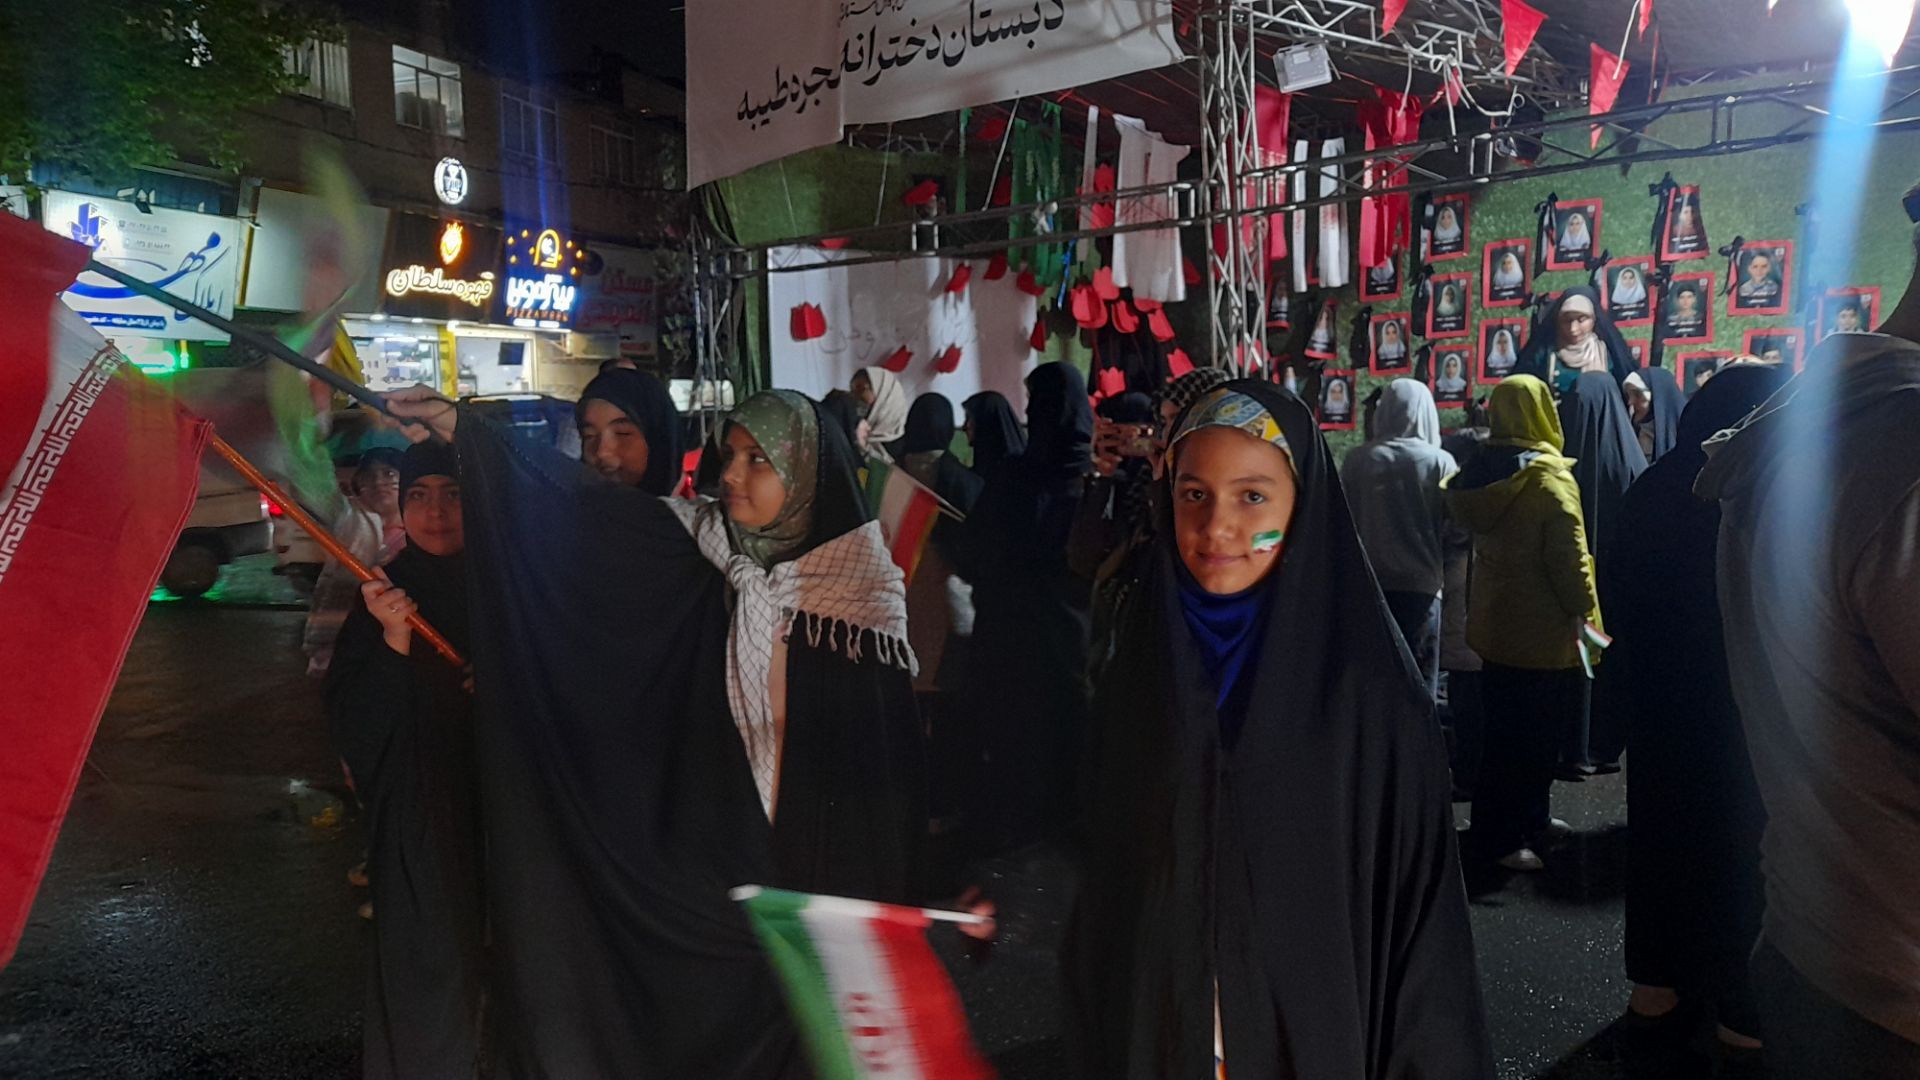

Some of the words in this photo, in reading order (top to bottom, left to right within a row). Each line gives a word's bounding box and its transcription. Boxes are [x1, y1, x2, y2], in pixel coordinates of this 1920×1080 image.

[943, 0, 1064, 67] دبستان
[737, 65, 789, 130] طیبه
[386, 264, 456, 297] سلطان
[455, 271, 495, 306] قهوه
